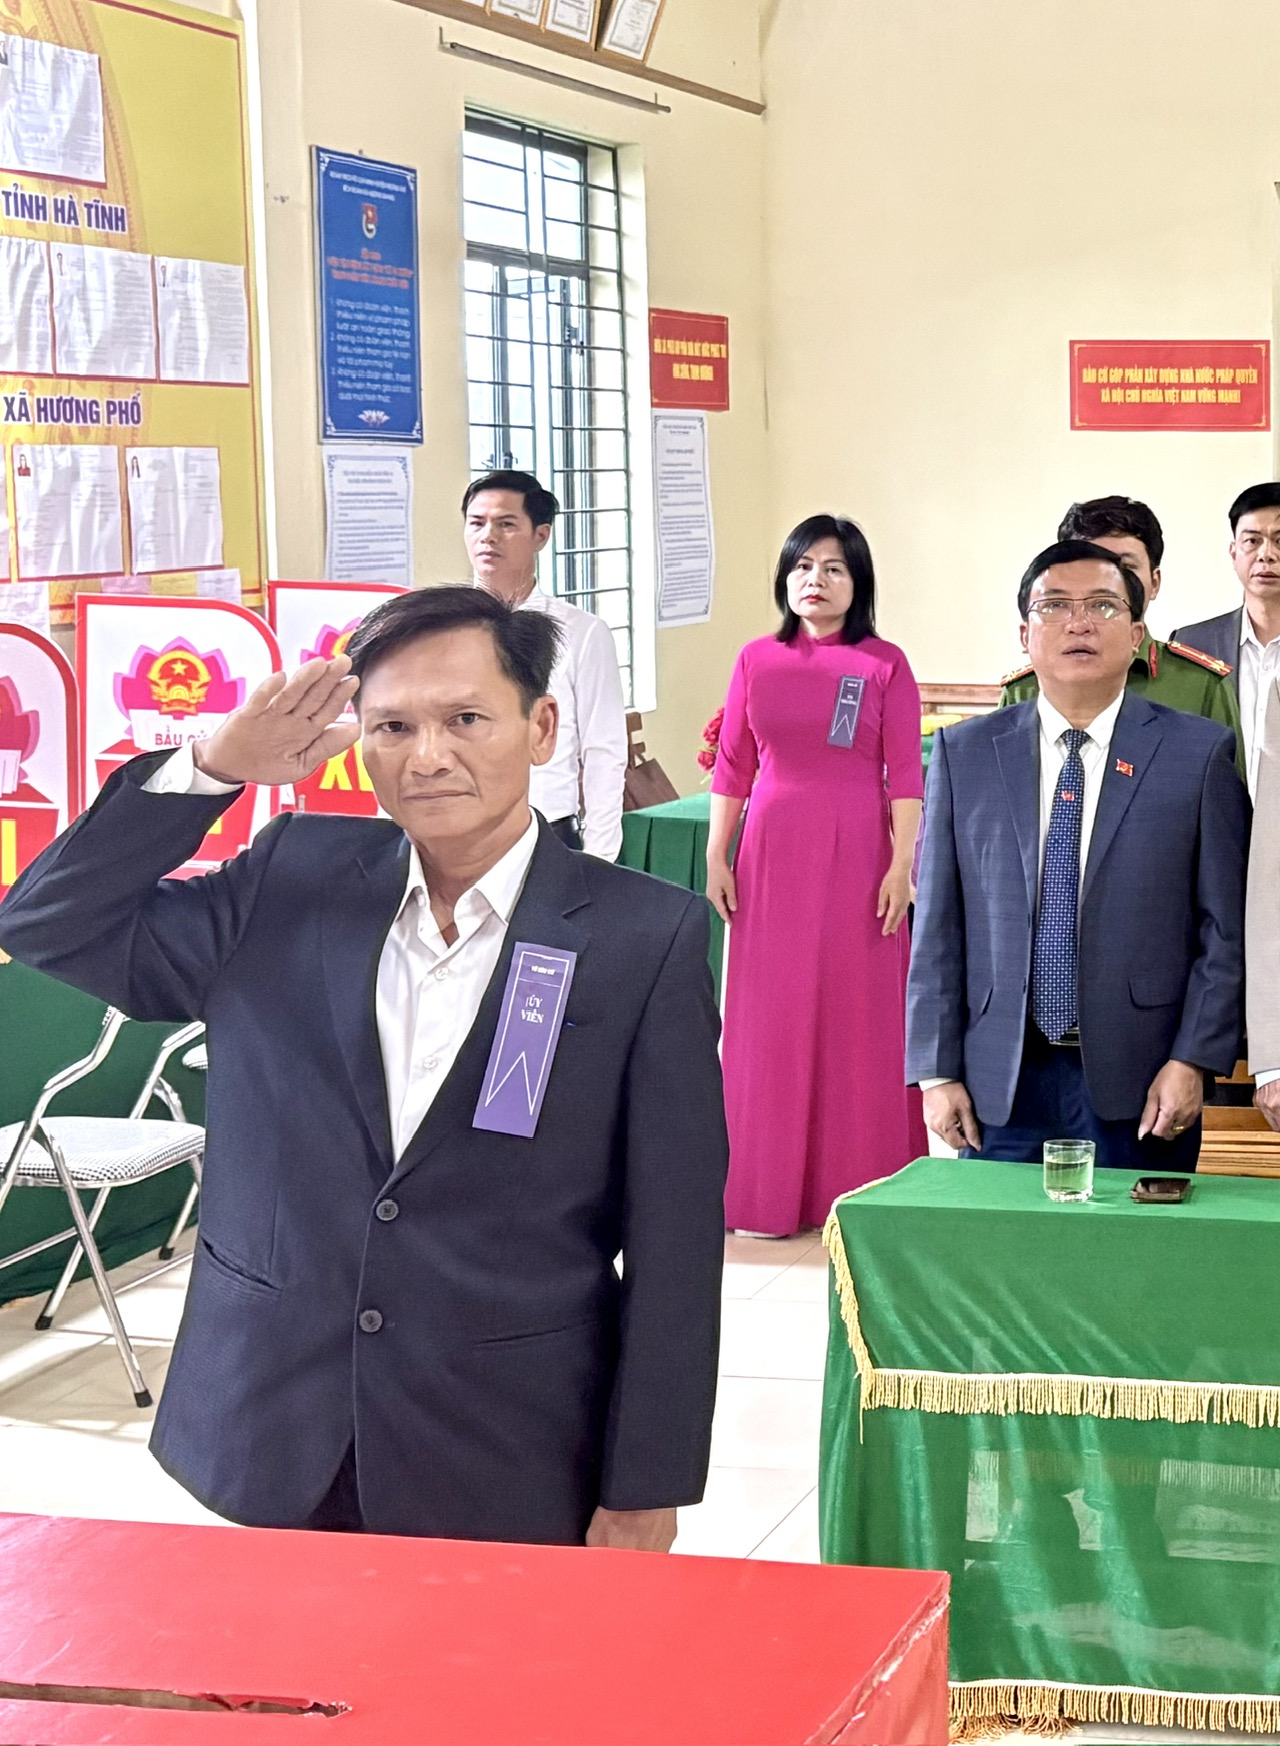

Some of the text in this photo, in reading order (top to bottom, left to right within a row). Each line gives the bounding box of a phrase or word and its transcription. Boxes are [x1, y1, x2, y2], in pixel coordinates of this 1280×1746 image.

[1, 183, 127, 232] TỈNH HÀ TĨNH
[3, 391, 31, 422] XÃ
[36, 396, 101, 424] HƯƠNG
